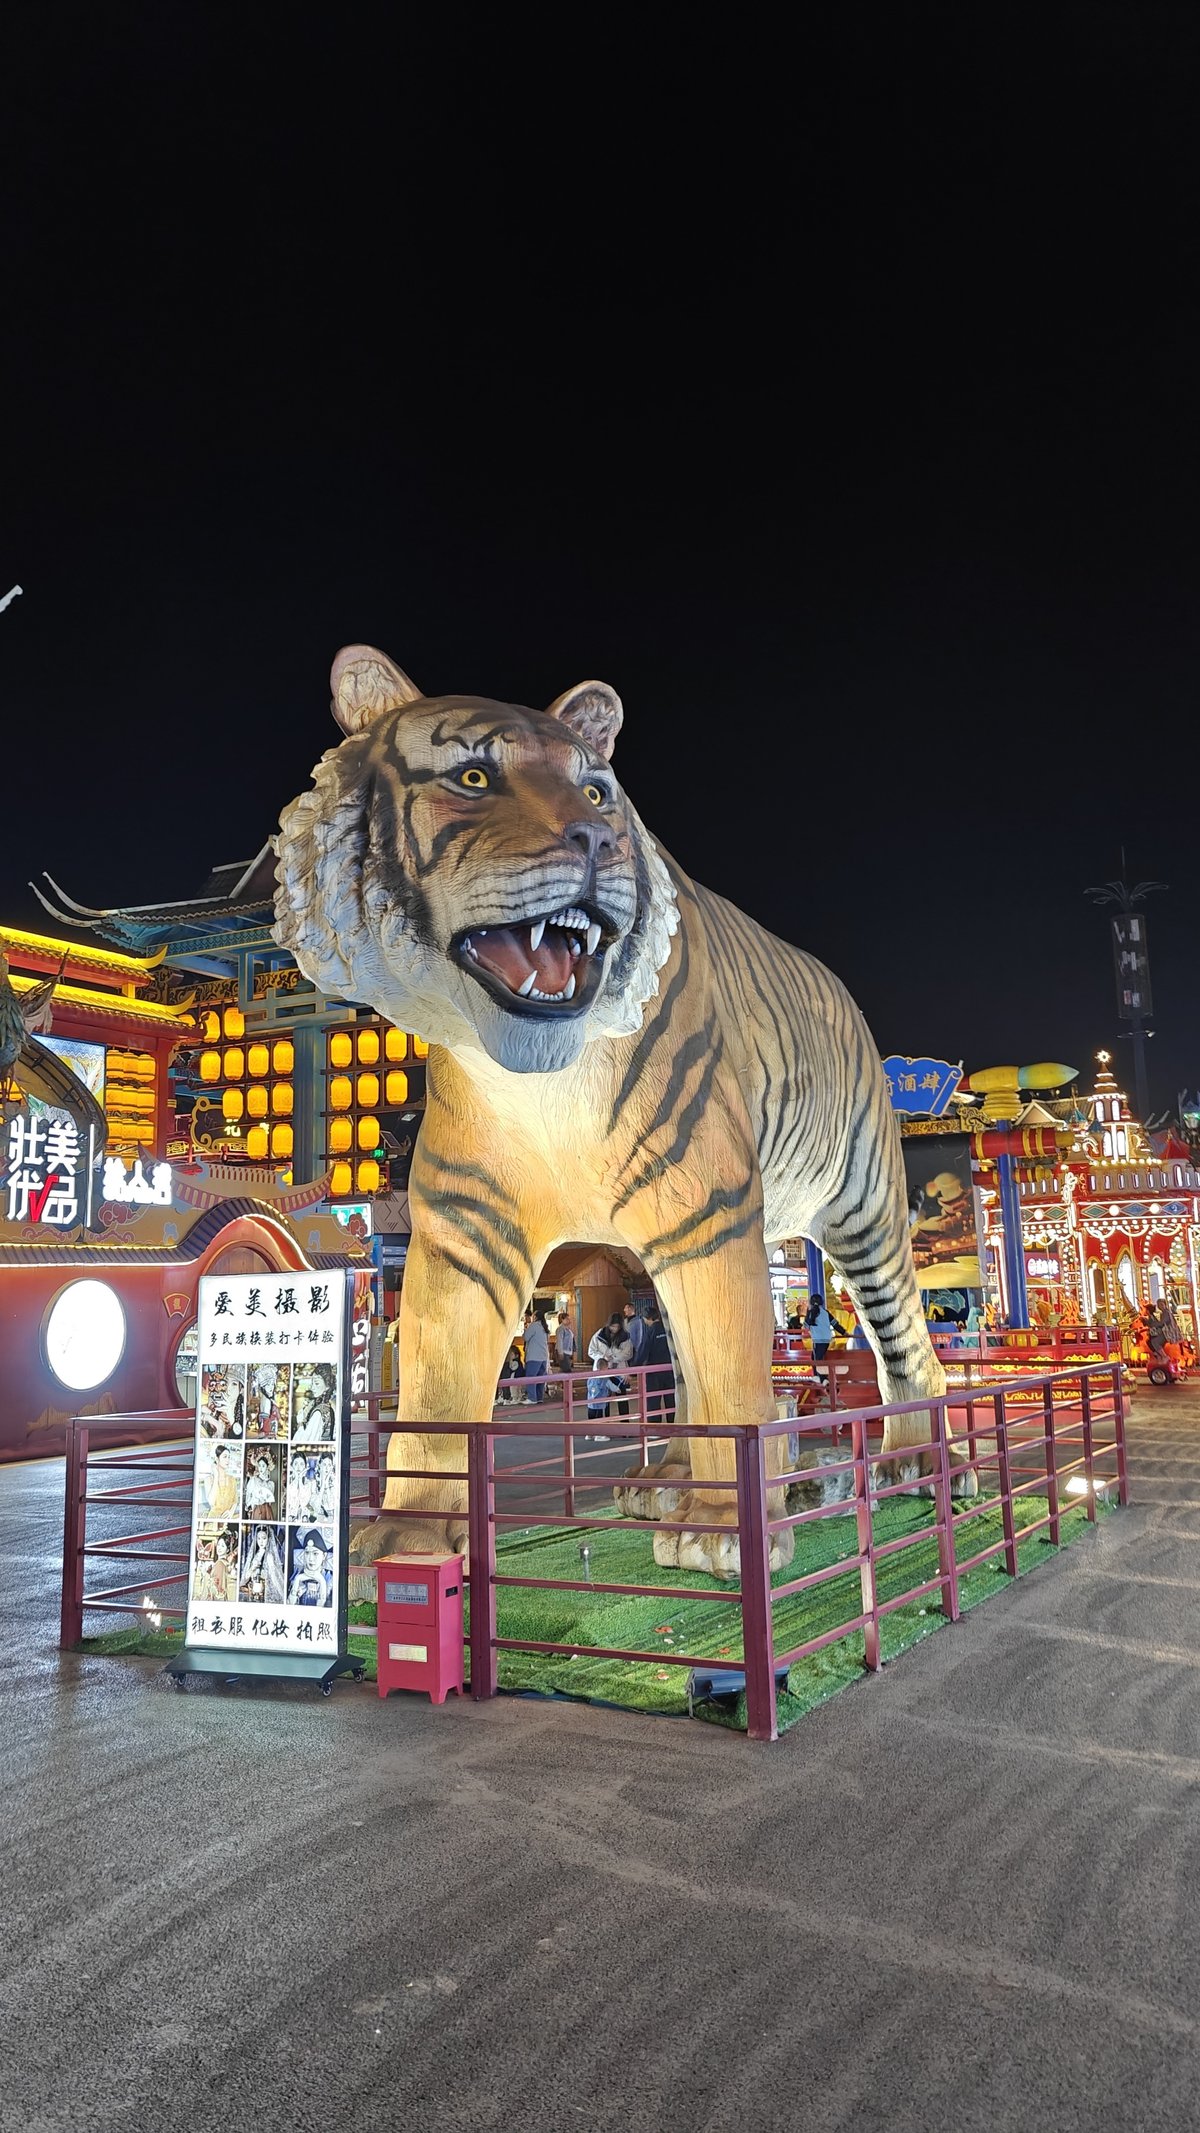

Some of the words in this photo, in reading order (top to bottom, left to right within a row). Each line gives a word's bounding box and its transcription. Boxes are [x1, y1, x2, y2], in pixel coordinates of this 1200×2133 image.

[8, 1114, 81, 1176] 壮美
[214, 1285, 330, 1317] 爱美摄影
[209, 1329, 335, 1348] 多民族换装打卡体验
[191, 1616, 245, 1637] 租衣服
[252, 1618, 290, 1638] 化妆
[296, 1620, 334, 1642] 拍照
